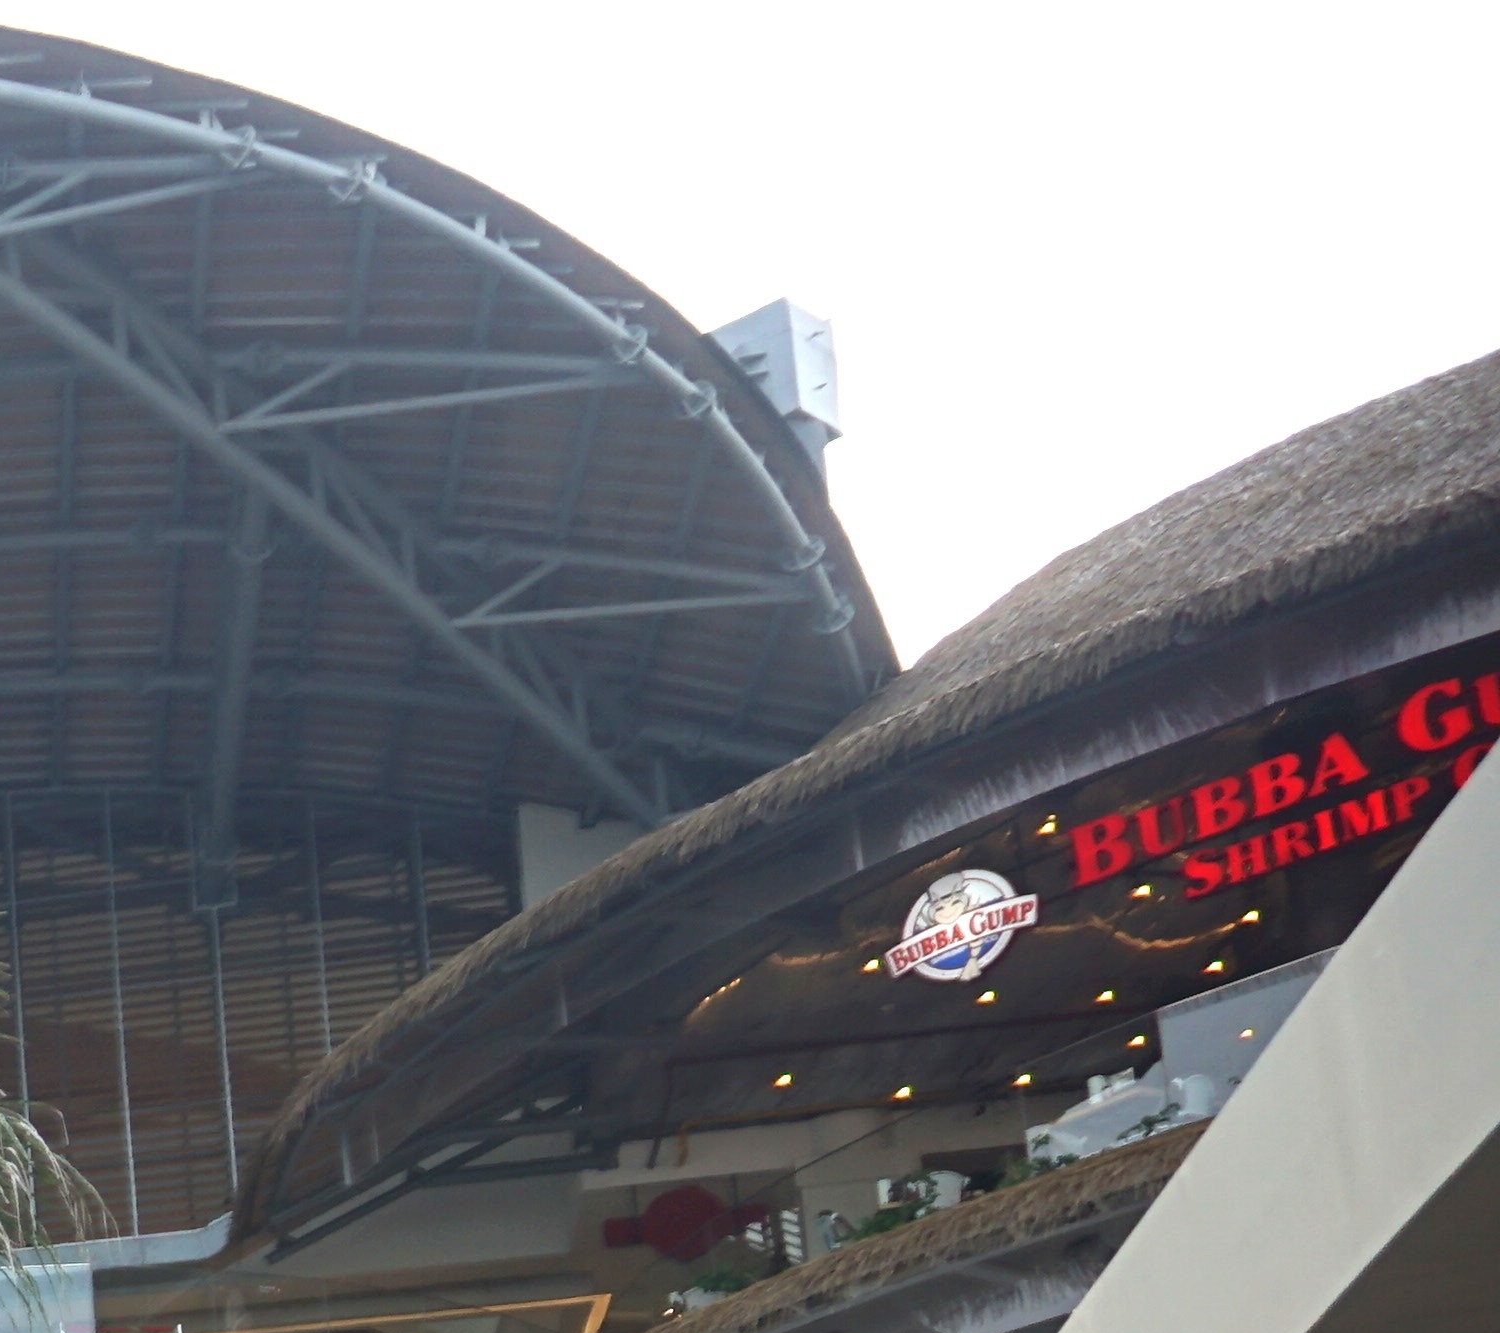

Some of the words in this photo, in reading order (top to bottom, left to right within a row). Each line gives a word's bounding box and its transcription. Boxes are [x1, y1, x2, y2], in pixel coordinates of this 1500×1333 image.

[1068, 732, 1370, 887] BUBBA
[1182, 775, 1431, 899] SHRIMP
[890, 926, 965, 971] BUBBA
[969, 900, 1035, 936] GUMP
